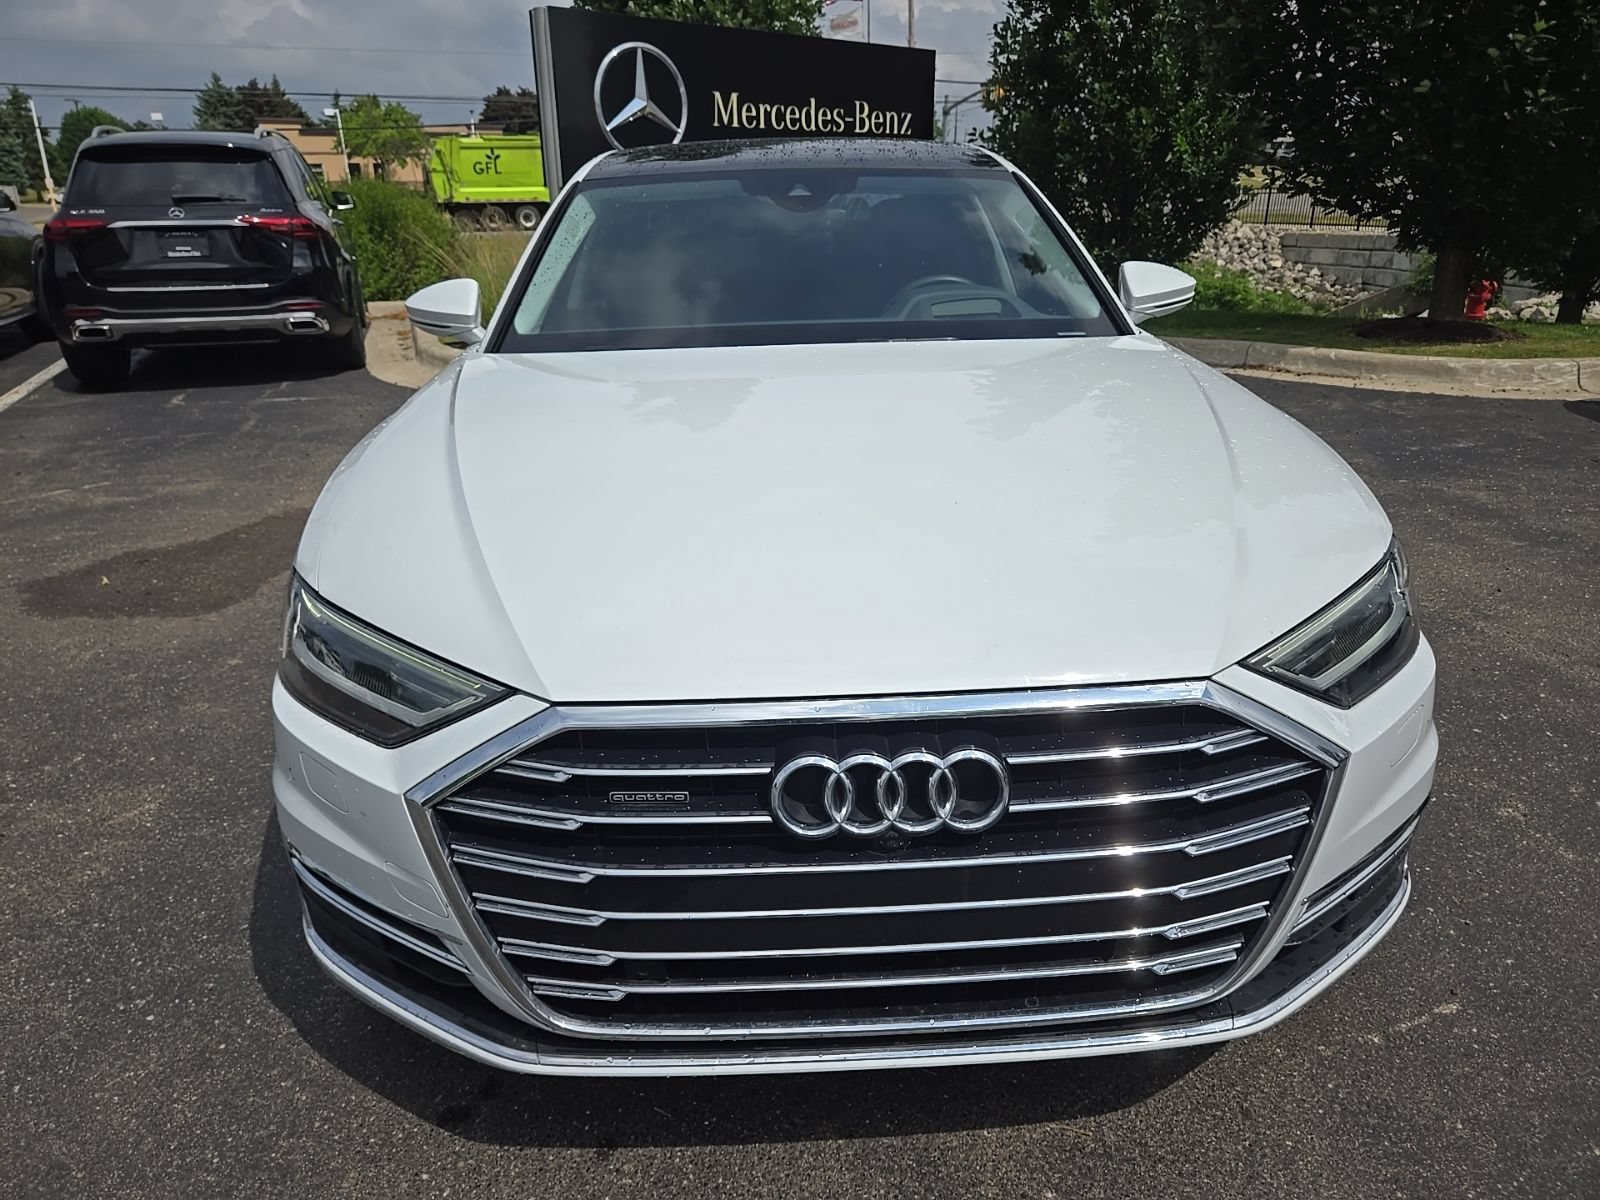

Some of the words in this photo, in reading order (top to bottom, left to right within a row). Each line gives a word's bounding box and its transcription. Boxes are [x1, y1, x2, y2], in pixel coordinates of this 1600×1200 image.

[712, 91, 912, 135] Mercedes-Benz
[473, 155, 503, 175] GFL
[612, 793, 685, 802] quattro
